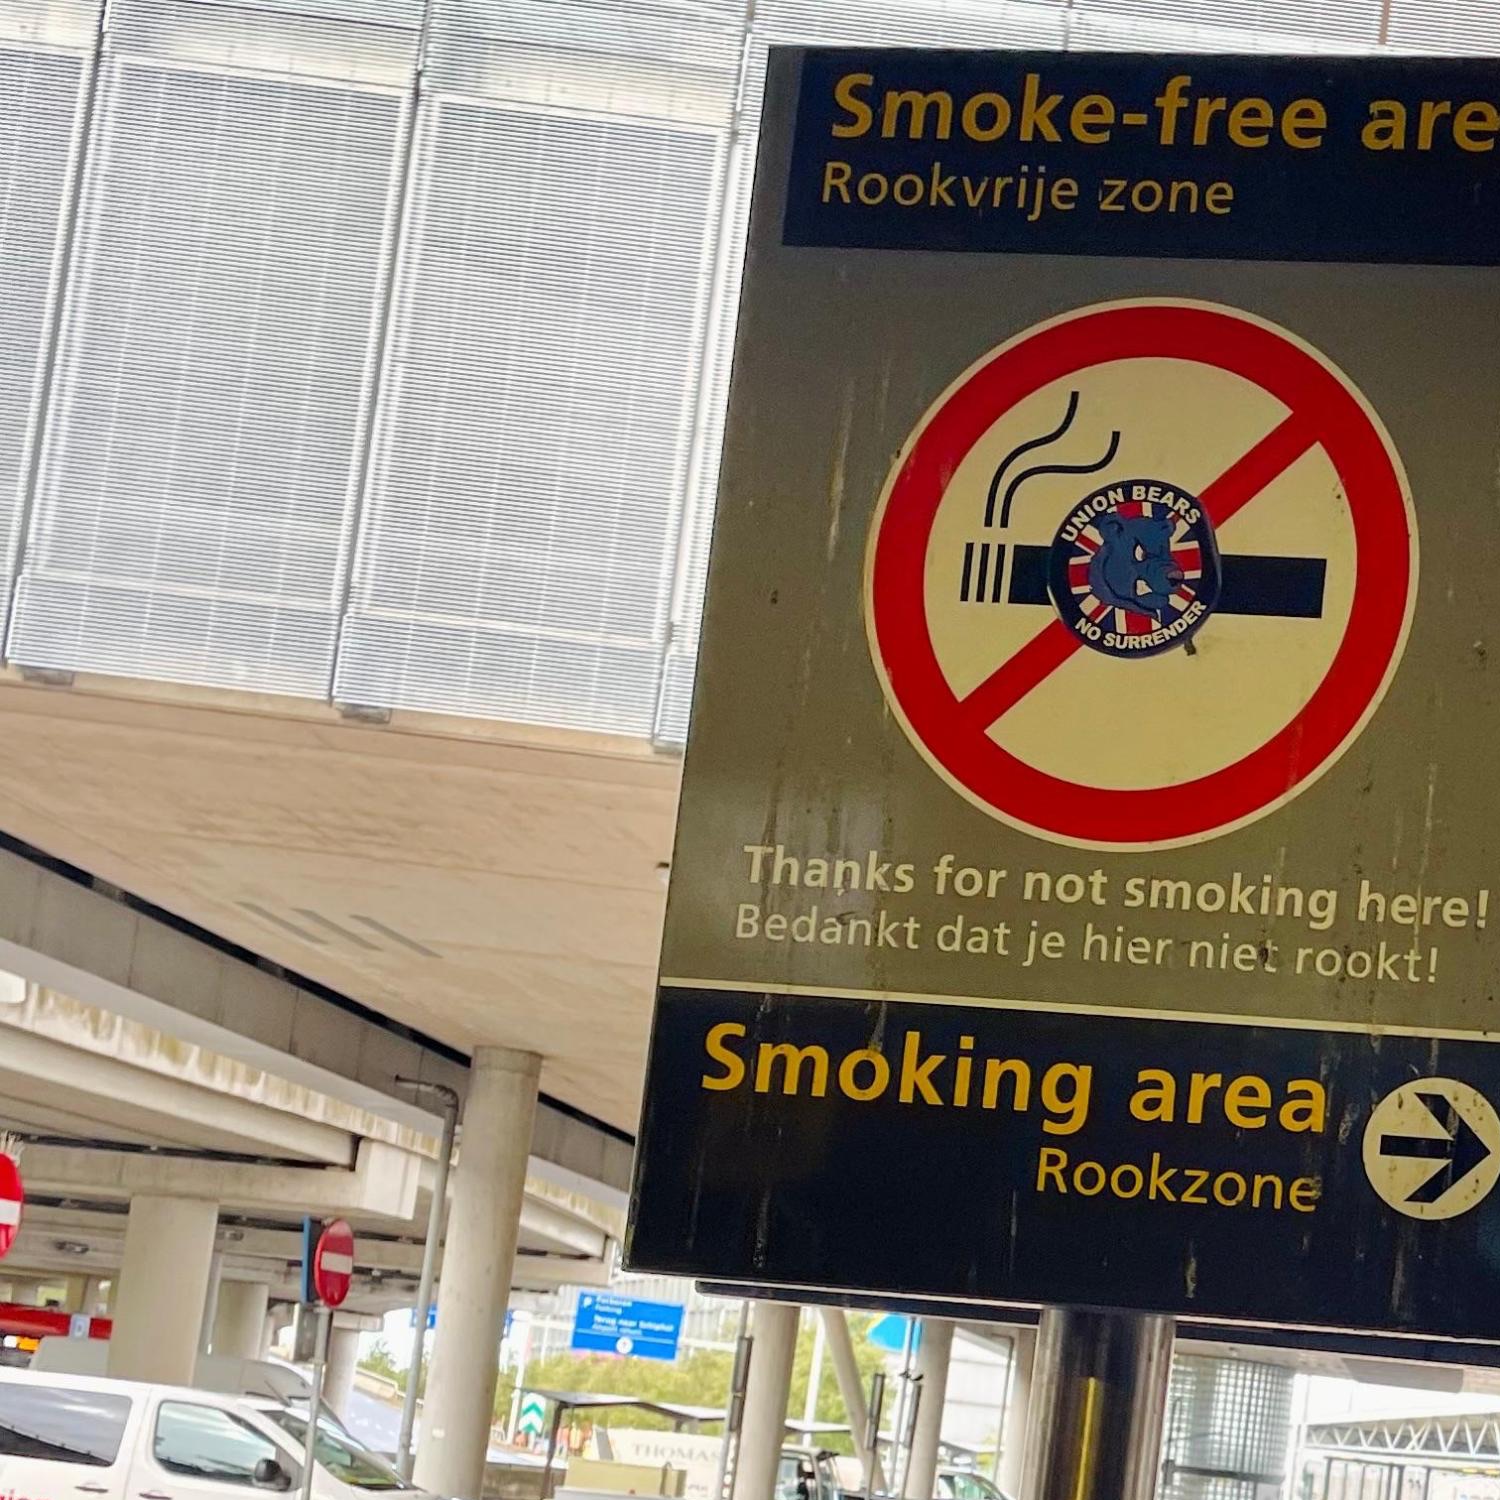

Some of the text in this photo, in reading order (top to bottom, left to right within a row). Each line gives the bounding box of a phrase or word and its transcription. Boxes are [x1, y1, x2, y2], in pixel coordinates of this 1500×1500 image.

[832, 72, 1328, 149] Smoke-free
[822, 161, 1234, 221] Rookvrije zone
[1061, 485, 1201, 542] UNION BEARS
[1075, 600, 1208, 650] NO SURRENDER
[744, 844, 1490, 930] Thanks for not smoking here!
[735, 903, 1439, 983] Bedankt dat je hier niet rookt!
[702, 1022, 1327, 1136] Smoking area
[1036, 1147, 1322, 1213] Rookzone
